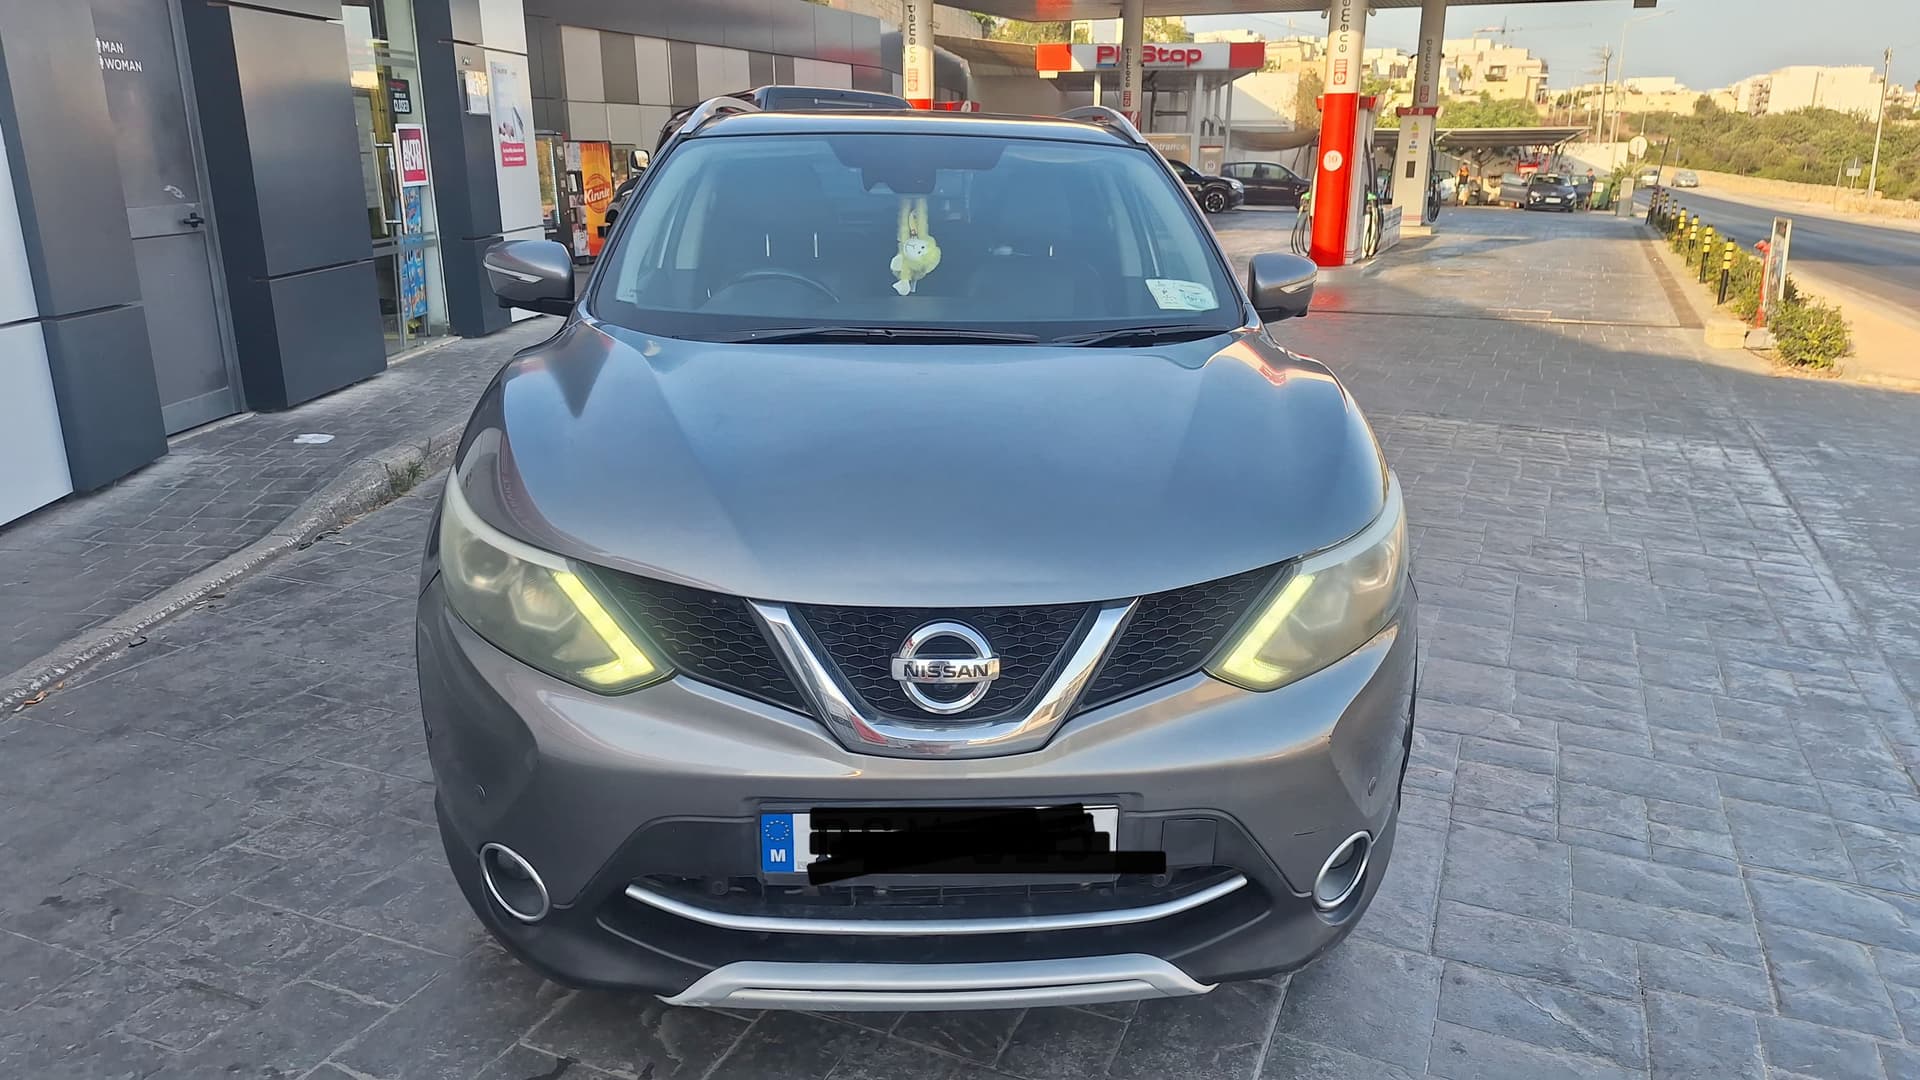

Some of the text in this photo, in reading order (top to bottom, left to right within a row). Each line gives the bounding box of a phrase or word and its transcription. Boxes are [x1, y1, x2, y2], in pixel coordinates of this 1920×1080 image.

[906, 4, 917, 63] enemed
[101, 40, 124, 54] MAN
[1142, 45, 1202, 66] Stop
[104, 58, 143, 72] WOMAN
[1153, 143, 1187, 151] ntrance
[584, 188, 610, 203] Kinnie
[903, 663, 989, 678] NISSAN
[770, 848, 786, 862] M
